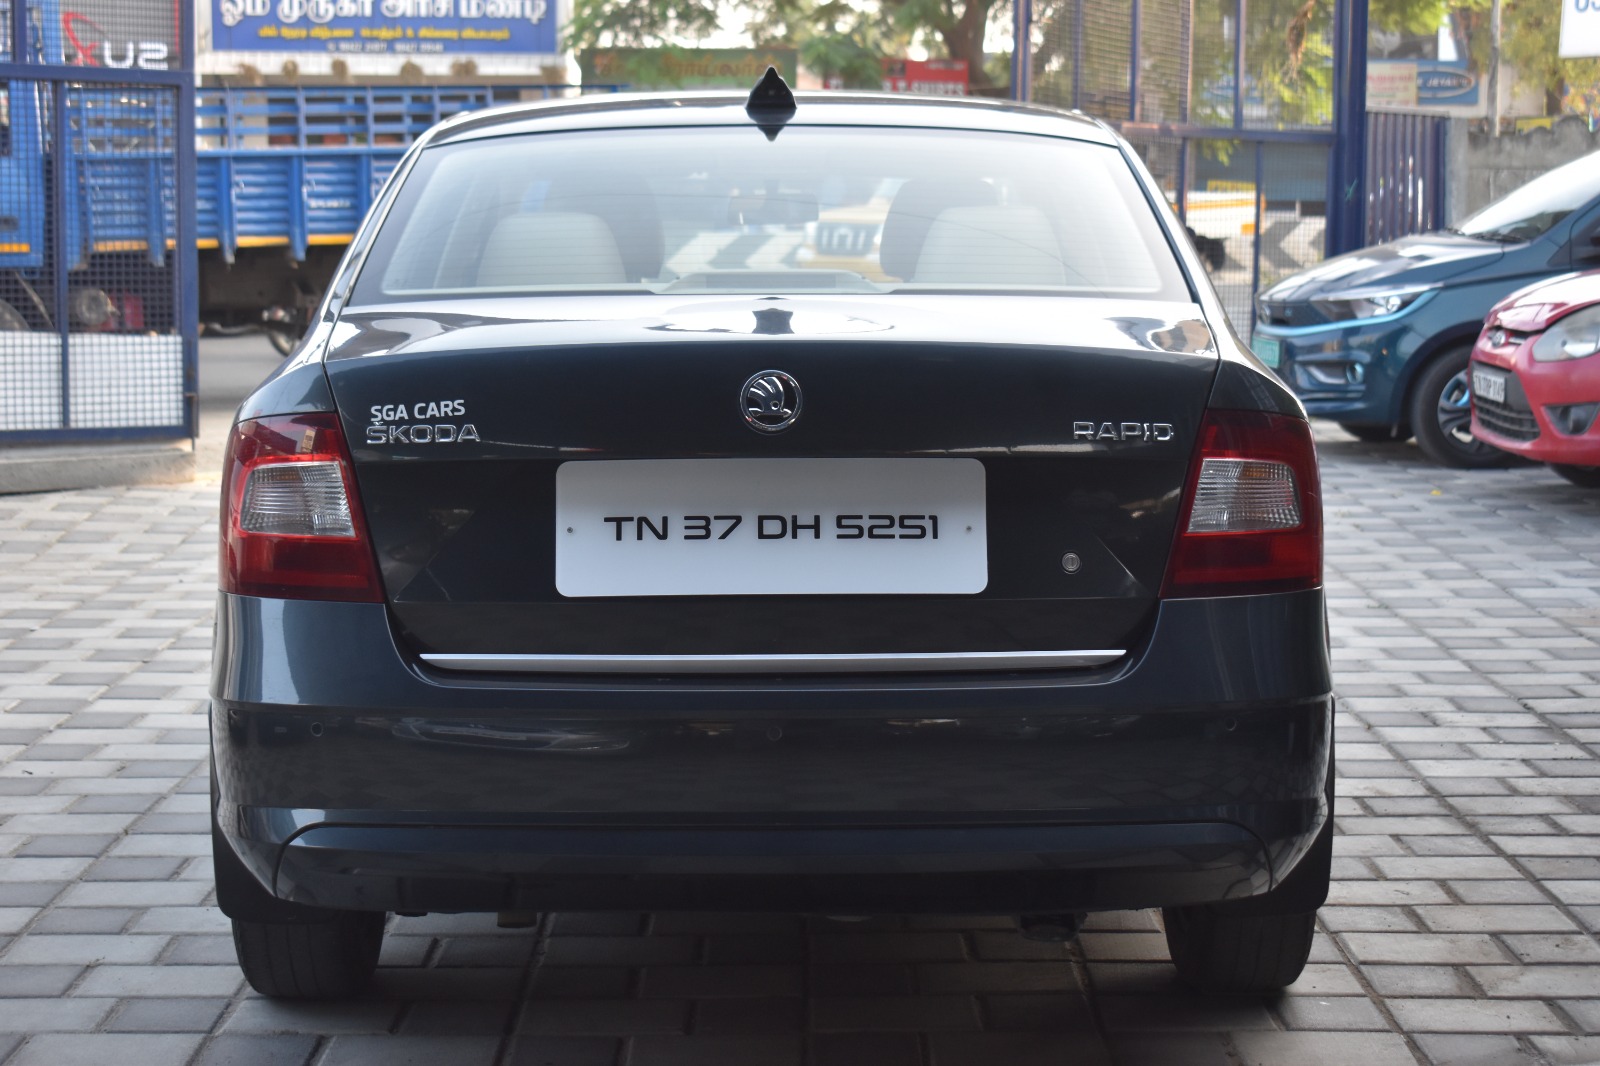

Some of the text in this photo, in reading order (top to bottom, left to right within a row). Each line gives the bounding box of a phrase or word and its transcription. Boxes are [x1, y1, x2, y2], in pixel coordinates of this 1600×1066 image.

[370, 399, 466, 422] SGA CARS
[1073, 421, 1174, 441] RAPID
[603, 514, 939, 541] TN 37 DH 5251
